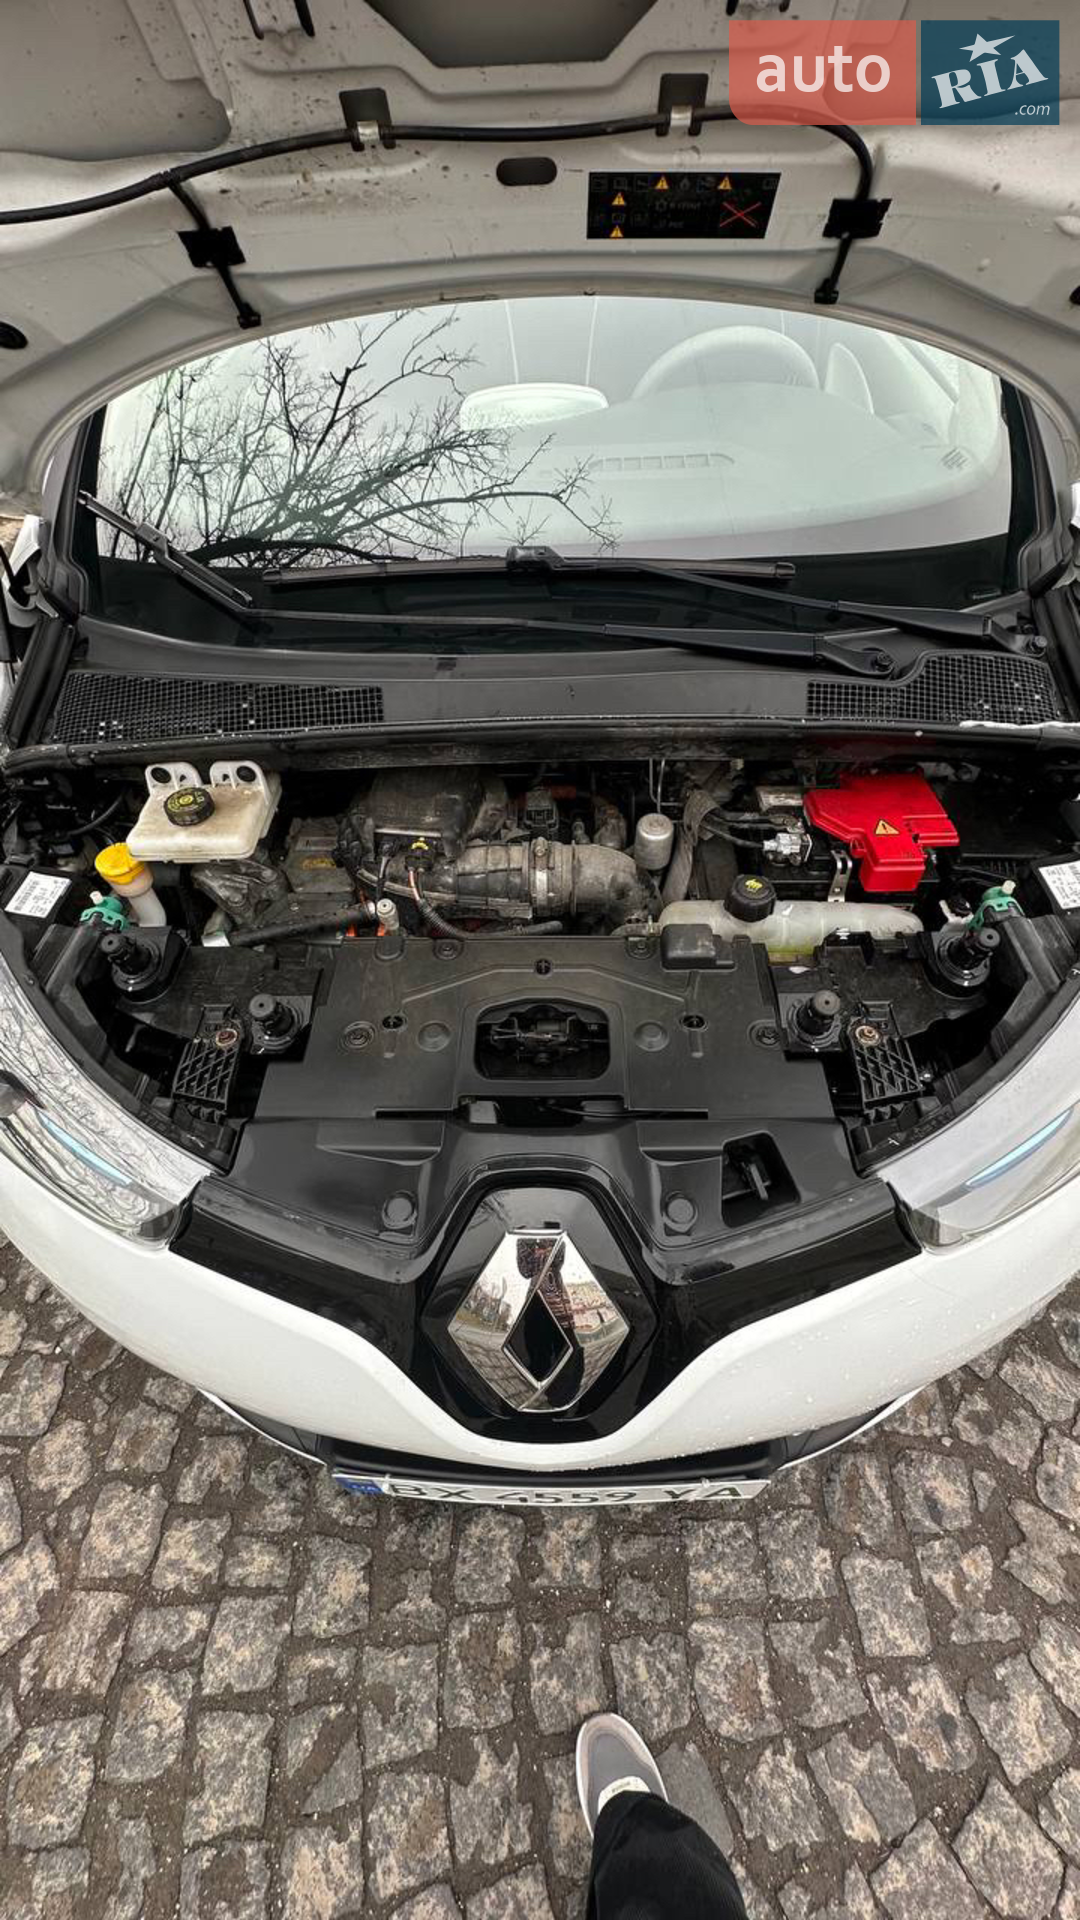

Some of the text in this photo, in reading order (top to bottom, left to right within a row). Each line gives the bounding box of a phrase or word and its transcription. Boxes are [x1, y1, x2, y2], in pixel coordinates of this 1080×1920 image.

[391, 1484, 475, 1501] BX
[496, 1491, 637, 1504] 4559
[664, 1486, 742, 1500] YA
